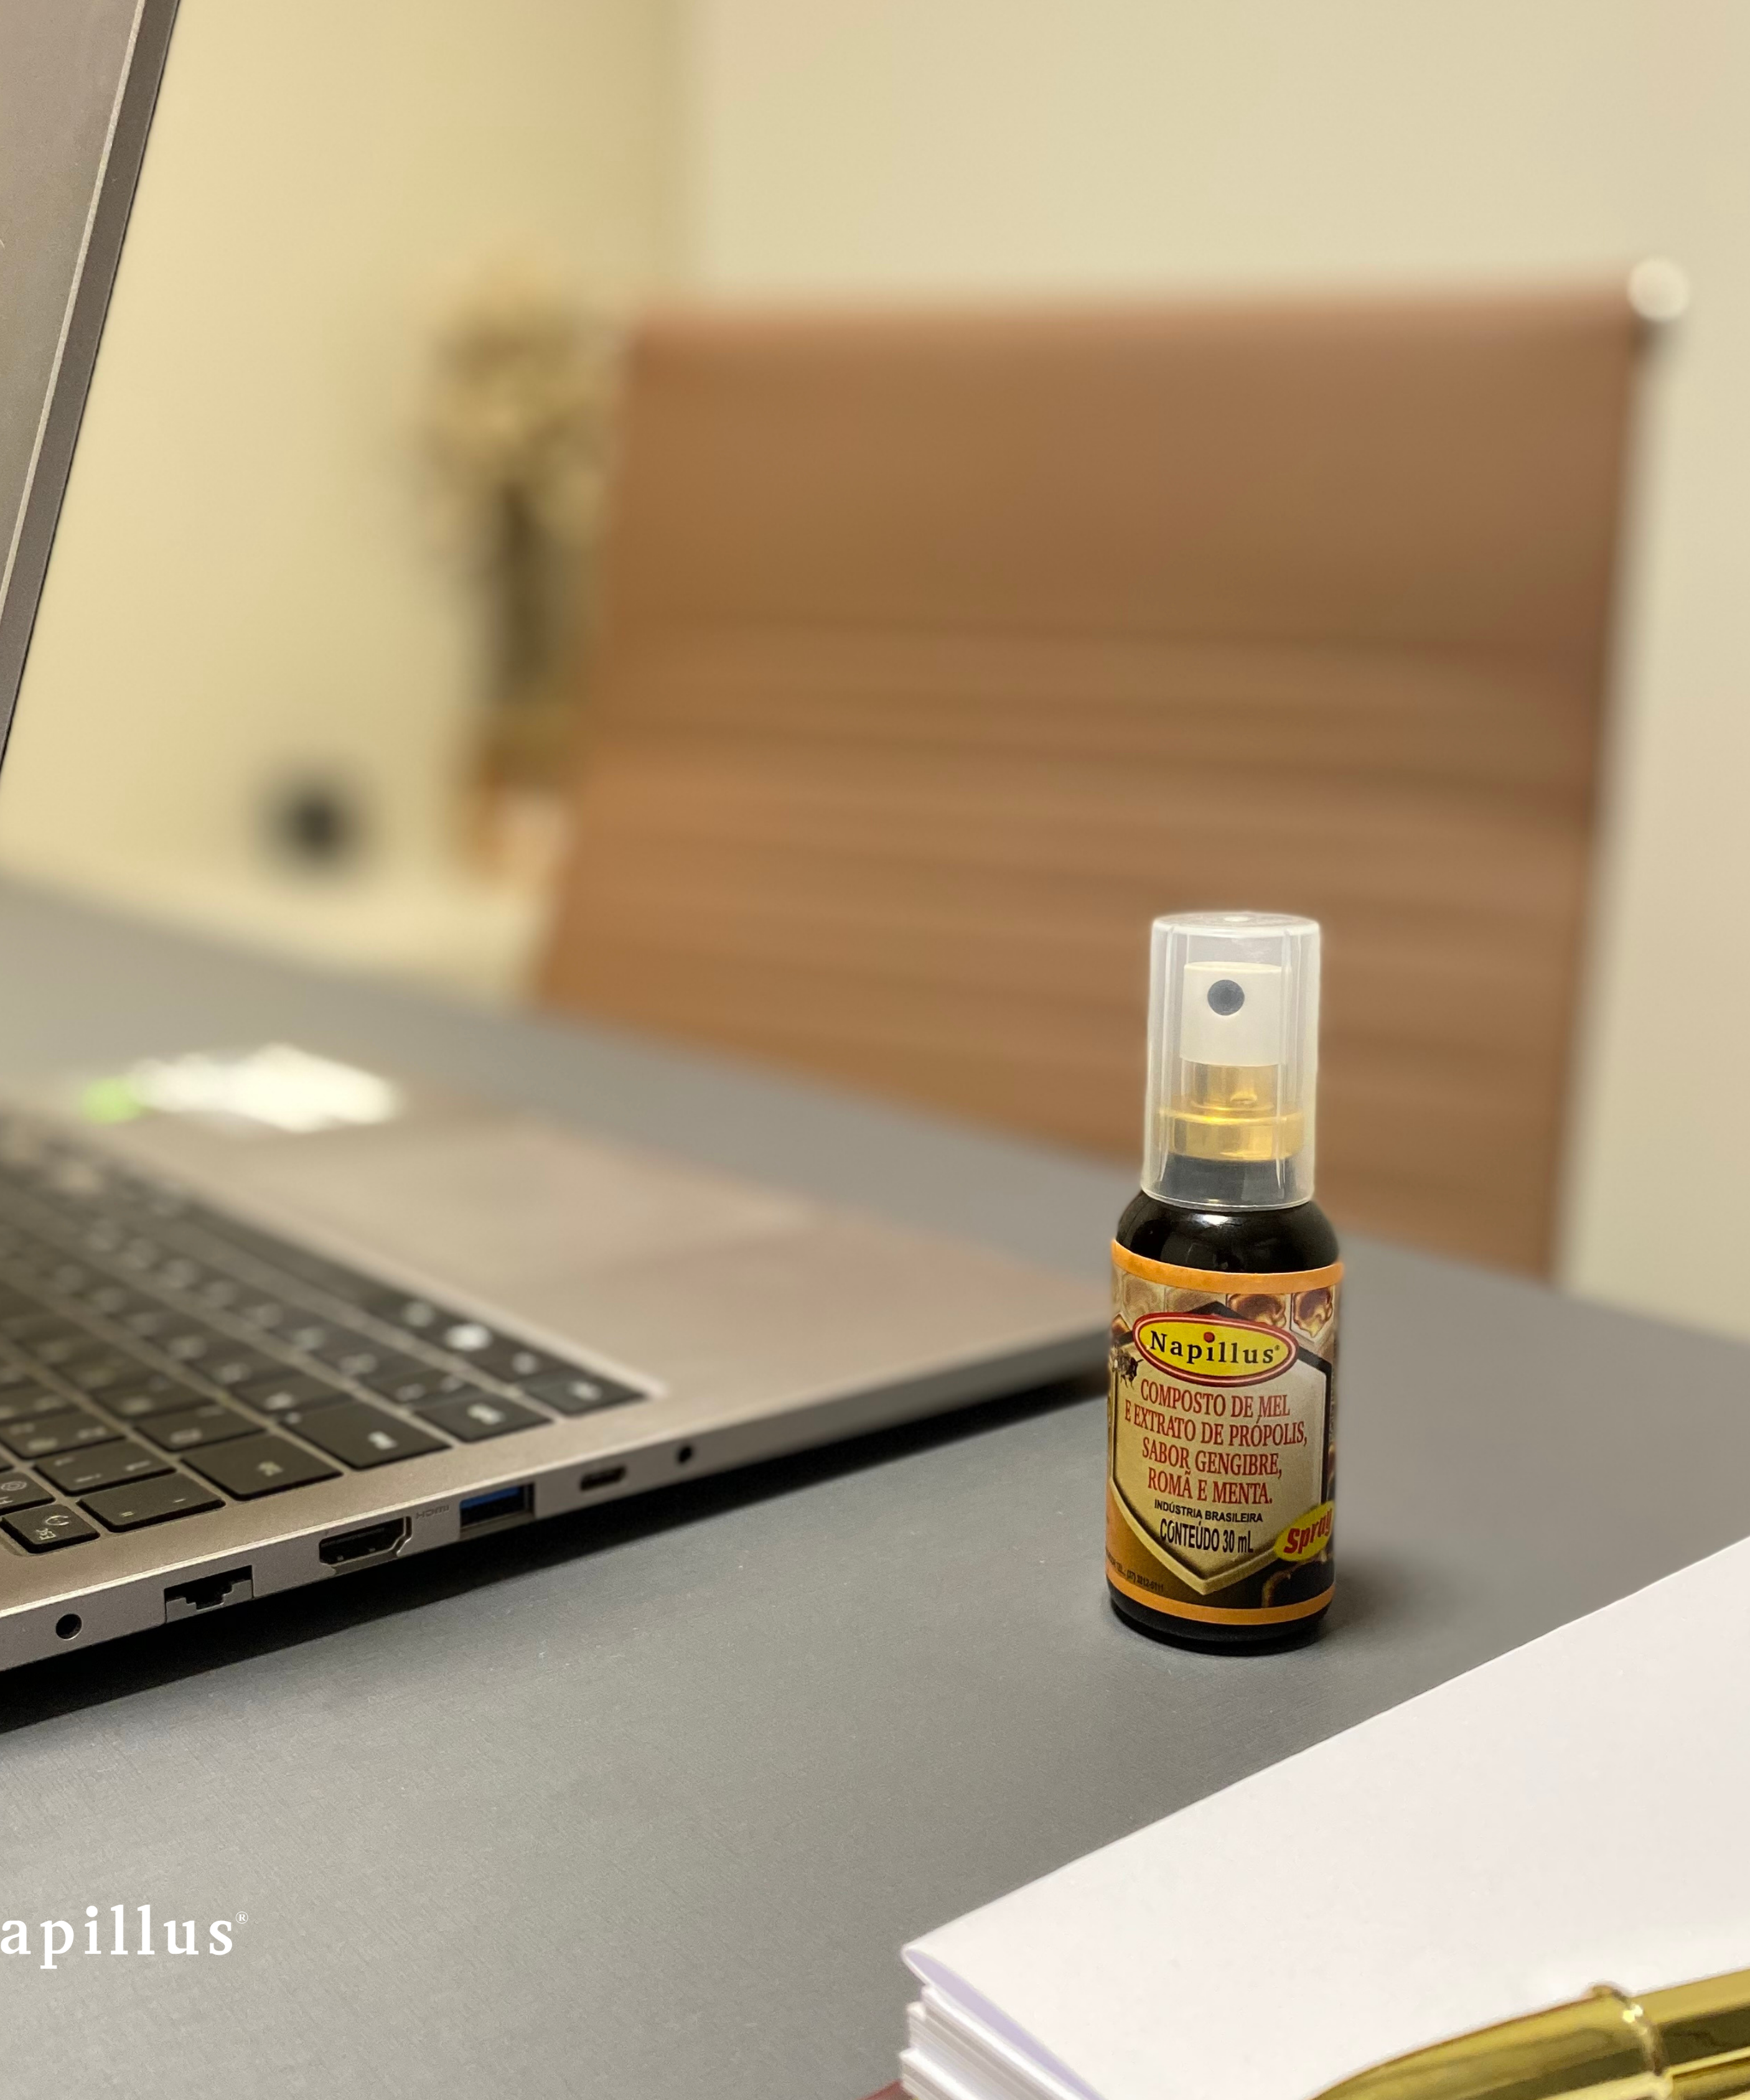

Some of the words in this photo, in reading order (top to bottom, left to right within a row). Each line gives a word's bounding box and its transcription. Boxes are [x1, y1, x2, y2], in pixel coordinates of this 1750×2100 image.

[1141, 1379, 1226, 1416] COMPOSTO
[1231, 1396, 1253, 1418] DE
[1258, 1394, 1290, 1417] MEL
[1125, 1399, 1131, 1421] E
[1134, 1404, 1196, 1442] EXTRATO
[1202, 1422, 1224, 1445] DE
[1229, 1417, 1308, 1447] PRÓPOLIS,
[1142, 1437, 1190, 1469] SABOR
[1195, 1450, 1283, 1479] GENGIBRE,
[1148, 1467, 1192, 1499] ROMÃ
[1197, 1480, 1207, 1501] E
[1213, 1481, 1273, 1504] MENTA.
[1154, 1499, 1202, 1519] INDÚSTRIA
[1205, 1511, 1263, 1523] BRASILEIRA
[1159, 1519, 1220, 1552] CONTEÚDO
[1222, 1533, 1235, 1552] 30
[1237, 1531, 1254, 1553] mL
[1283, 1508, 1332, 1554] Spray
